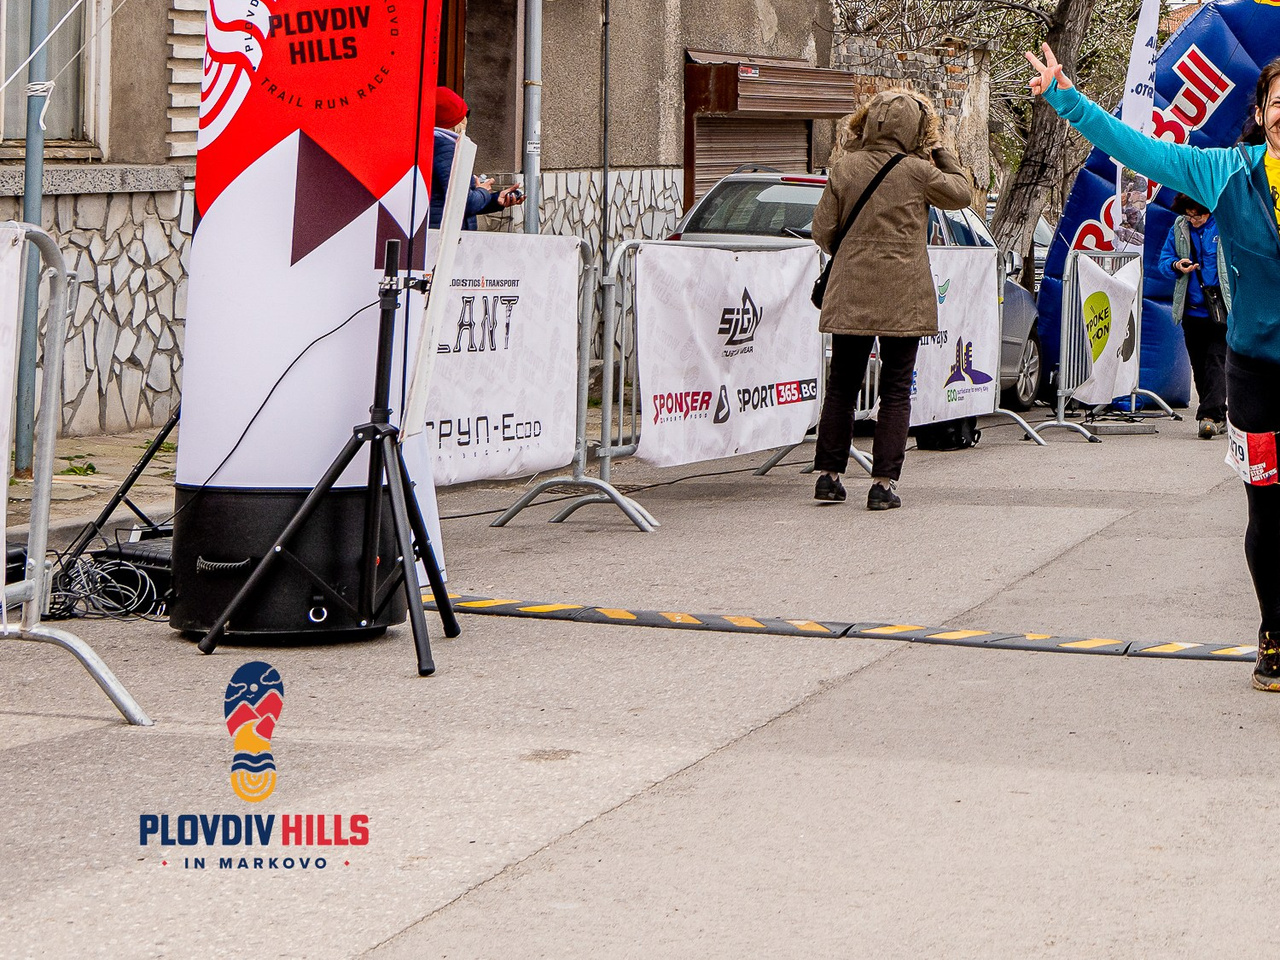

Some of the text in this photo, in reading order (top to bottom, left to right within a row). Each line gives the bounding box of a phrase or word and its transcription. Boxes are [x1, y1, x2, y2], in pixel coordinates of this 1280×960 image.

[268, 5, 371, 38] PLOVDIV
[289, 36, 357, 65] HILLS
[261, 77, 303, 108] TRAIL
[357, 66, 390, 99] RACE
[315, 97, 349, 110] RUN
[653, 391, 712, 425] SPONSER
